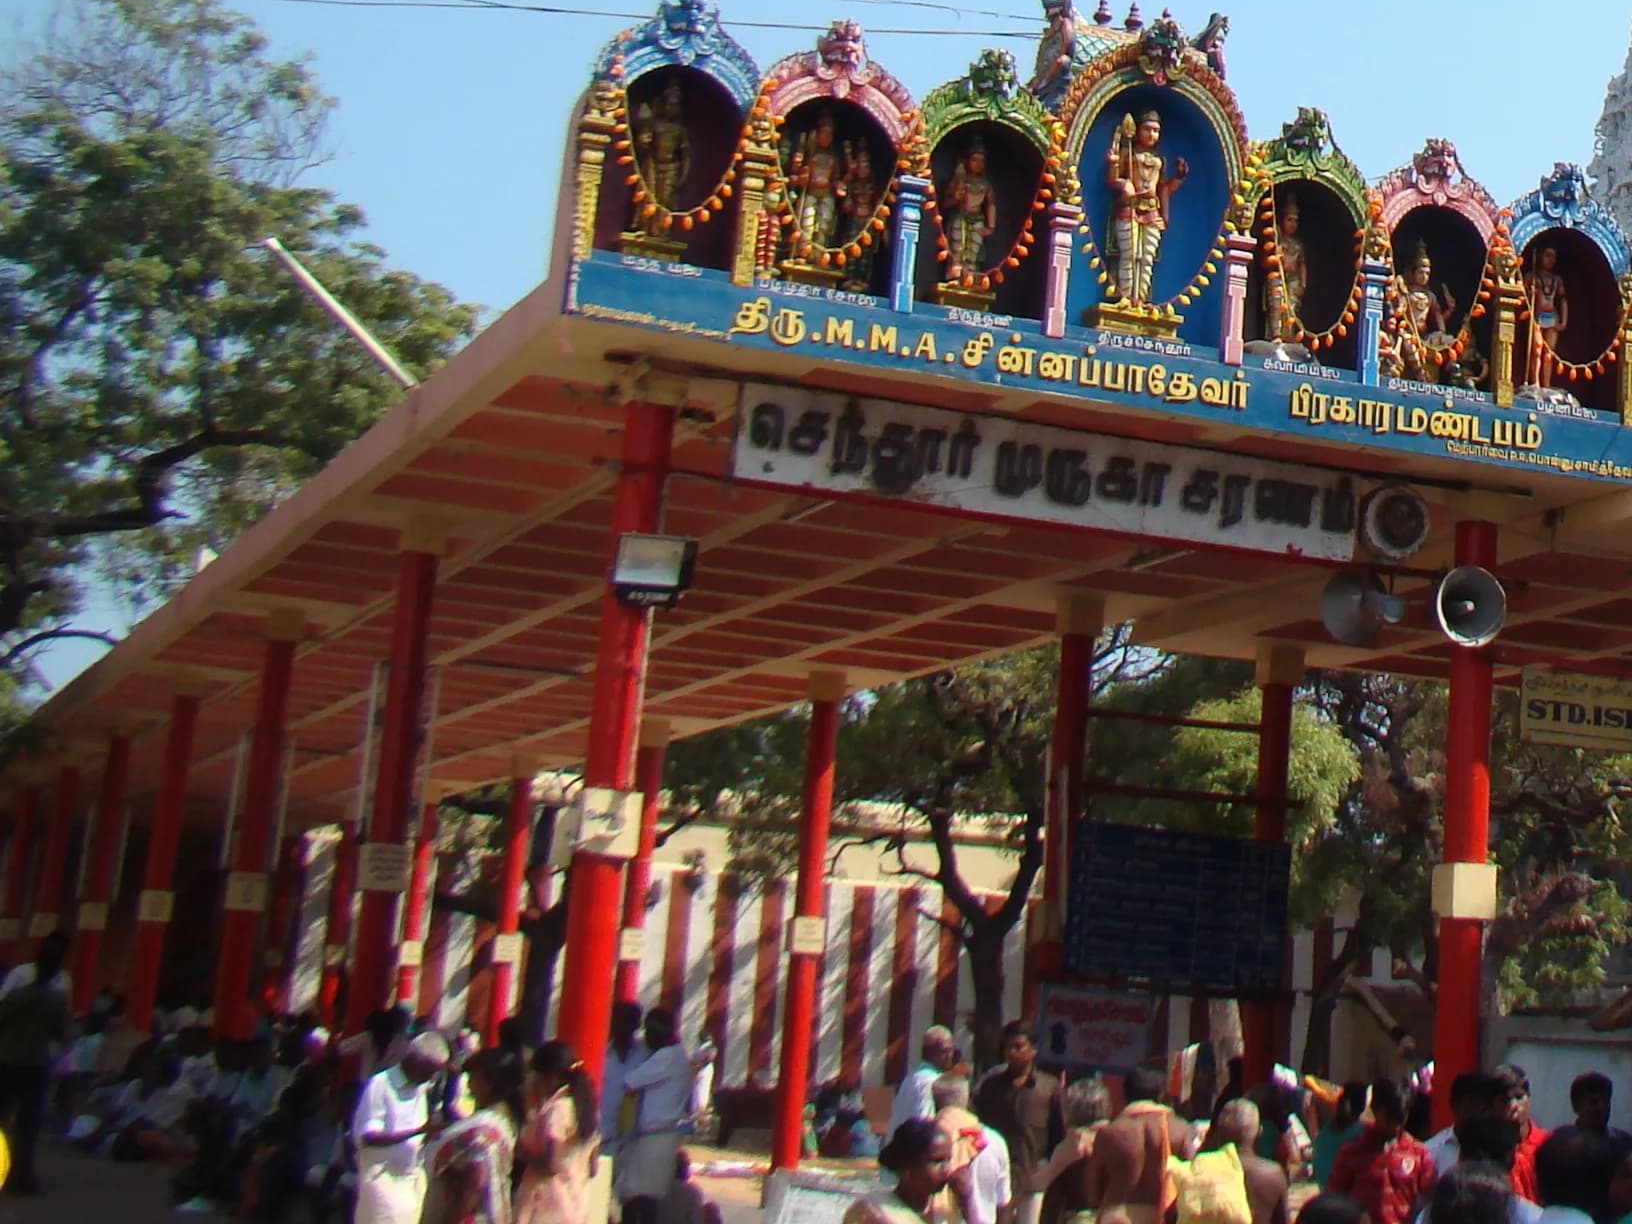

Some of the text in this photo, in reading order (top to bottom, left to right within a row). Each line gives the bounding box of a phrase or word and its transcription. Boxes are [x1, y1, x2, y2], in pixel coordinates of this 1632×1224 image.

[750, 398, 1354, 534] செந்தூர் முருகா சரணம்
